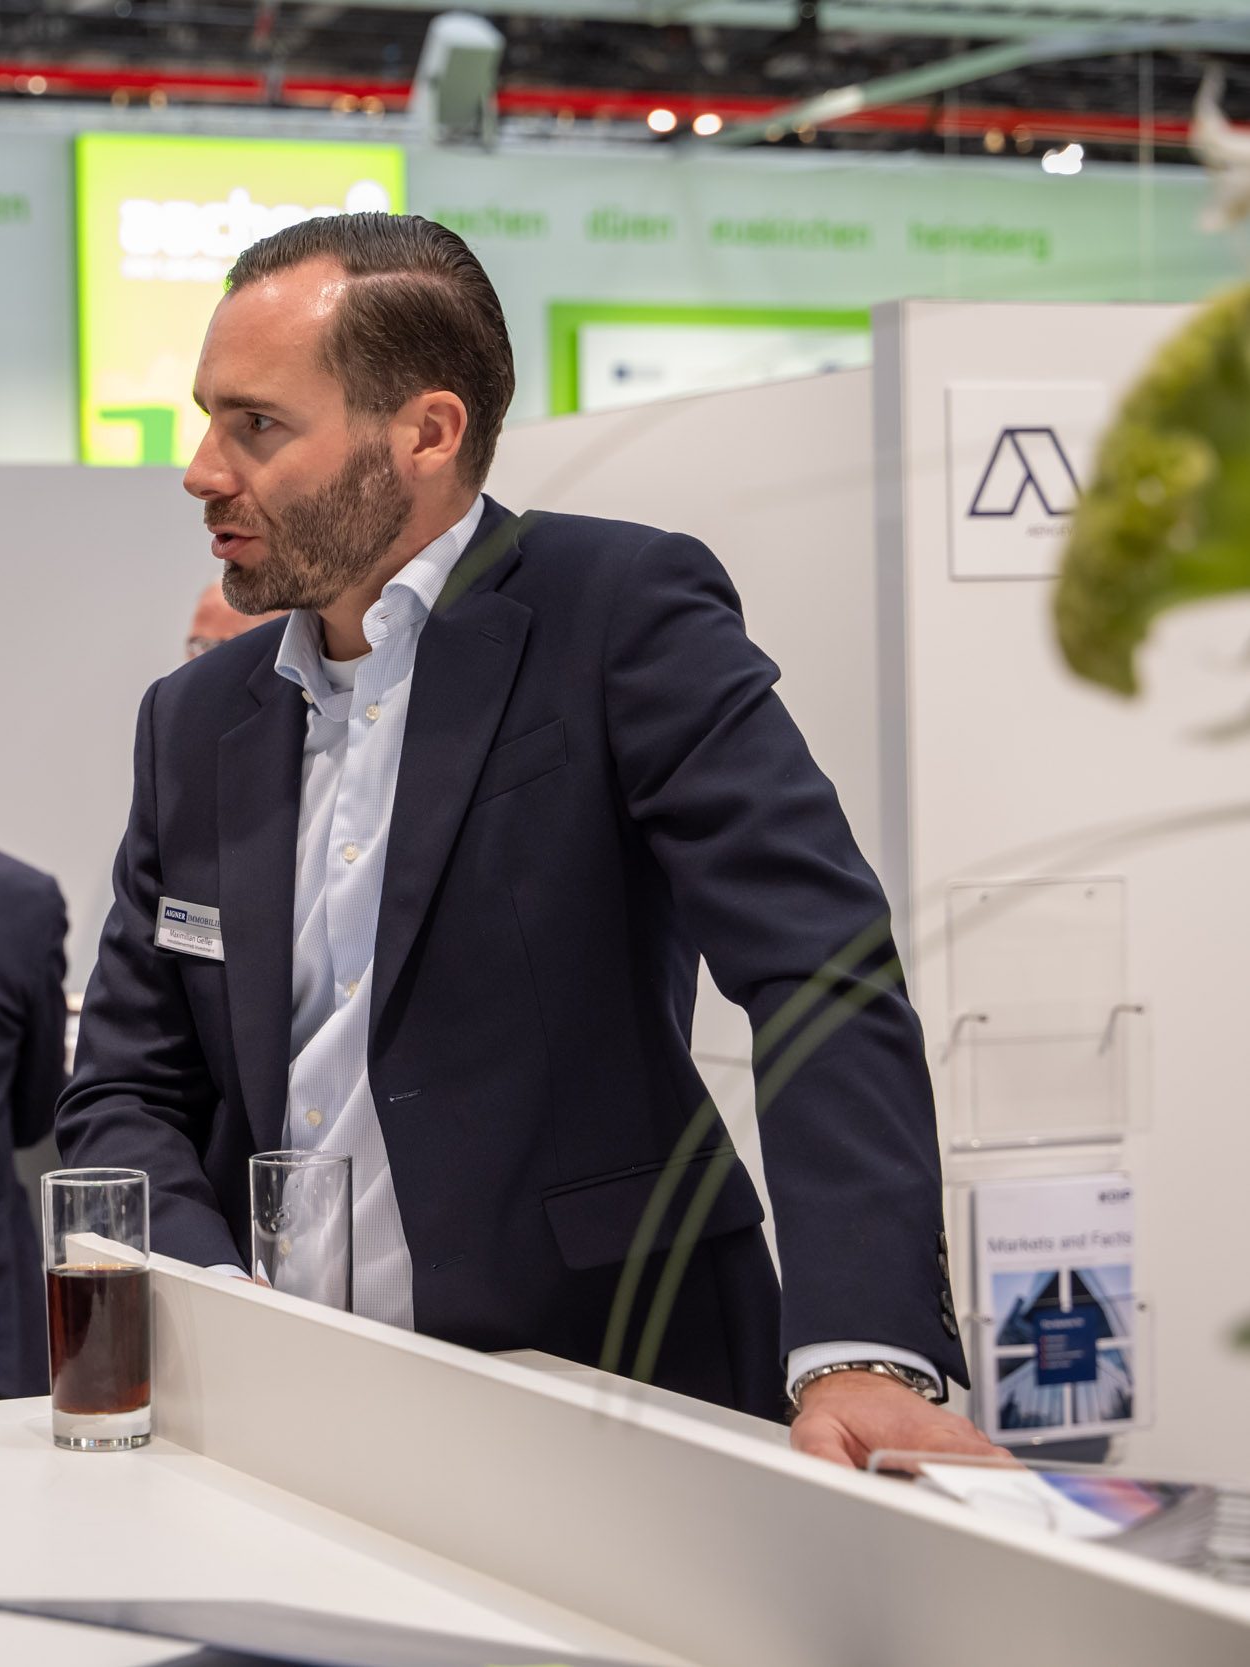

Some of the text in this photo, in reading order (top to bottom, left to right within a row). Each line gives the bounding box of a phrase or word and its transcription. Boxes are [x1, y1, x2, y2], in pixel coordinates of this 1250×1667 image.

[586, 207, 674, 243] düren
[710, 213, 872, 248] euskirchen
[908, 219, 1052, 262] heinsberg
[165, 909, 186, 920] AIGNER
[987, 1236, 1055, 1254] Markets
[1060, 1234, 1087, 1250] and
